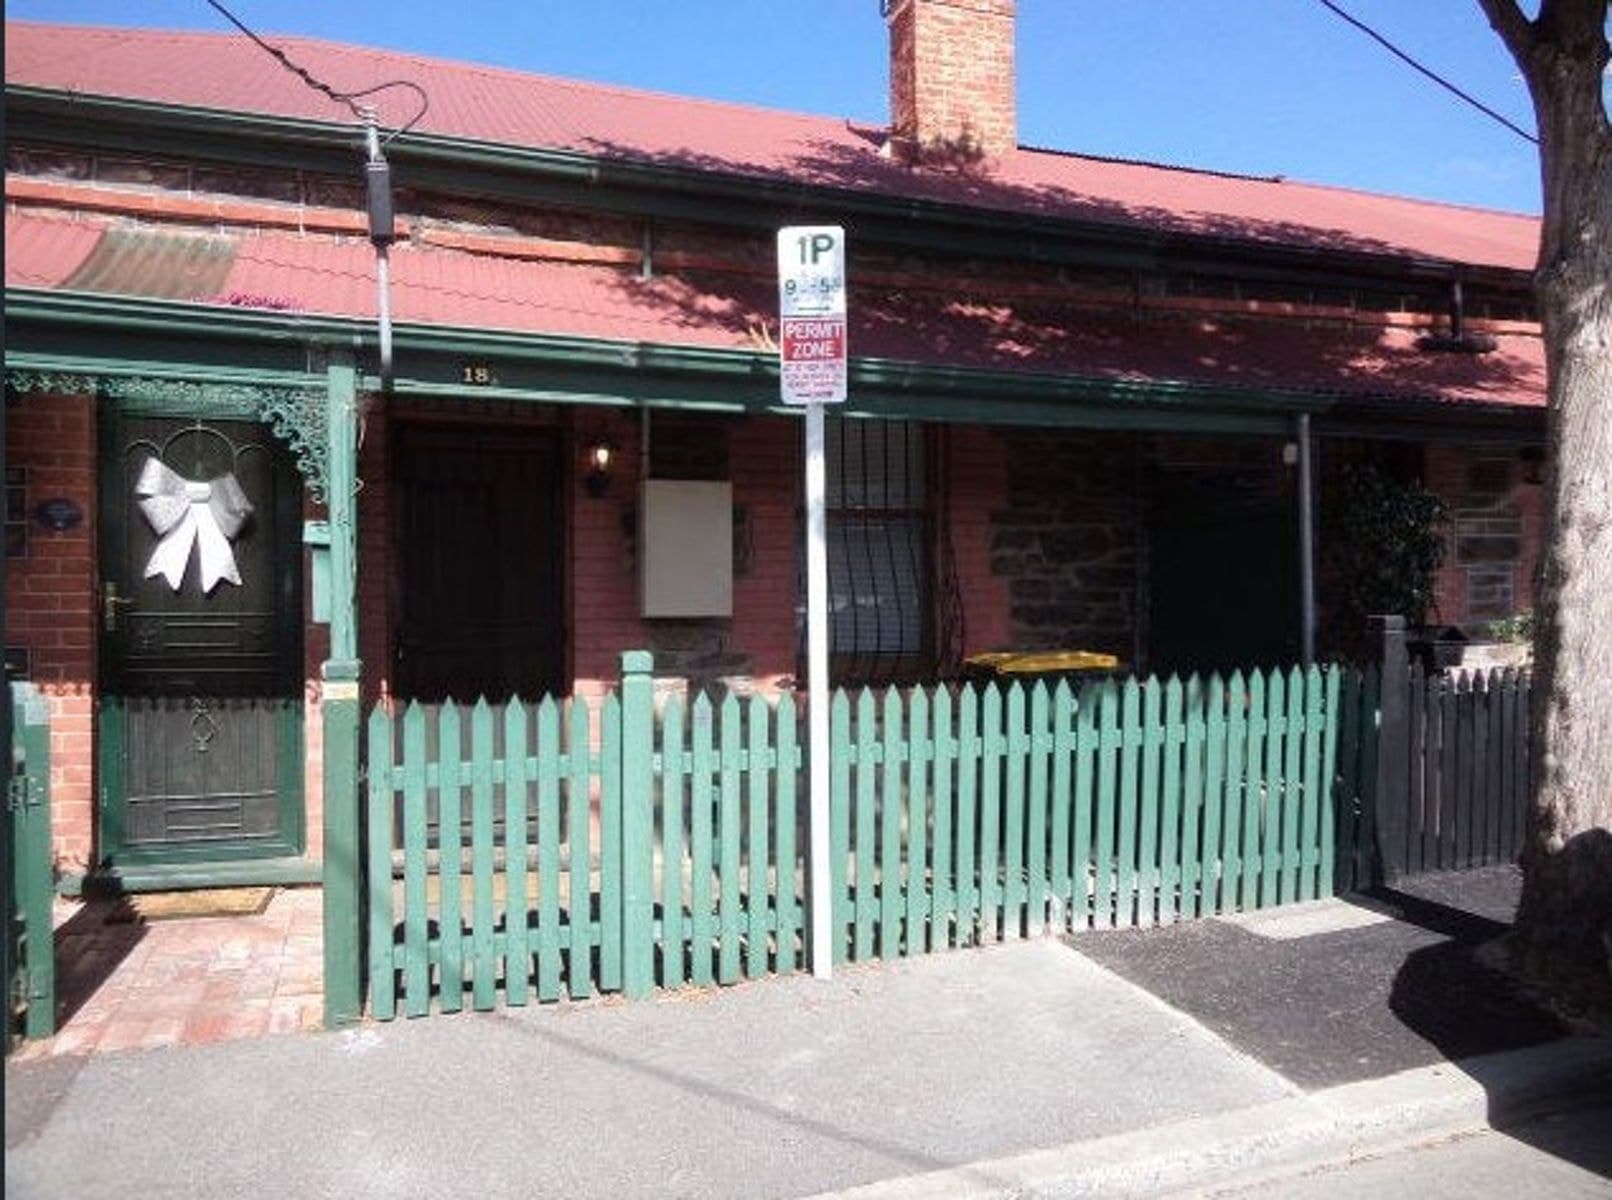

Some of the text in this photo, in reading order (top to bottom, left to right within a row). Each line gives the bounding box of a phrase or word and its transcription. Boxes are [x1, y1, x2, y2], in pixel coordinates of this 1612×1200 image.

[798, 233, 834, 265] 1P
[785, 323, 841, 339] PERMIT
[792, 341, 835, 359] ZONE
[464, 367, 488, 382] 18
